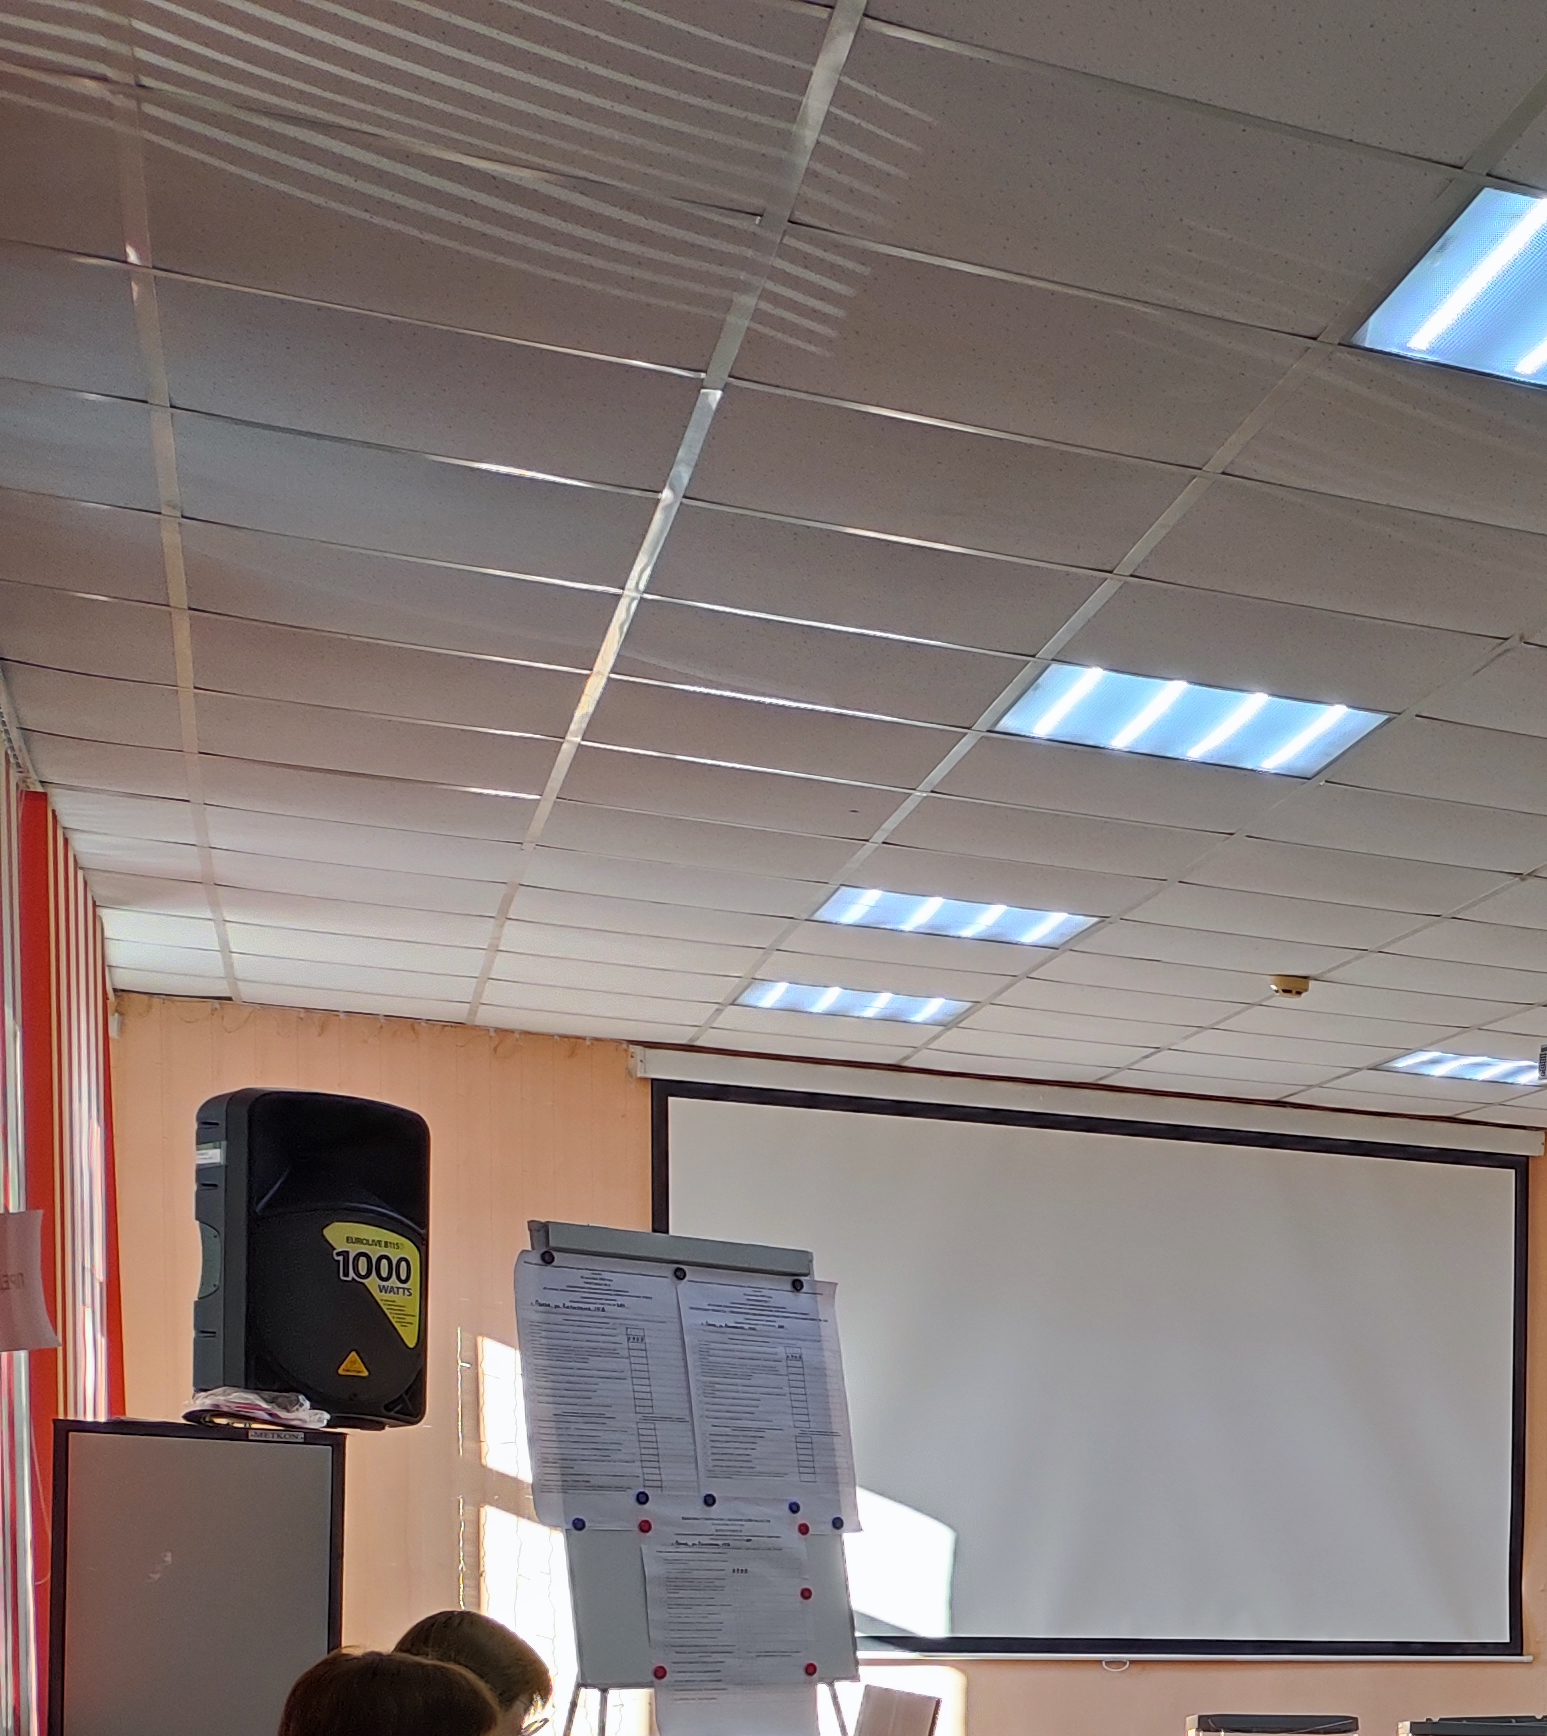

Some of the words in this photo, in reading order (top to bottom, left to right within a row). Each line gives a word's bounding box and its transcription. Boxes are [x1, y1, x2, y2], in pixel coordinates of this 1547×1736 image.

[345, 1236, 382, 1248] EUROLIVE
[335, 1250, 412, 1285] 1000
[378, 1284, 413, 1297] WATTS
